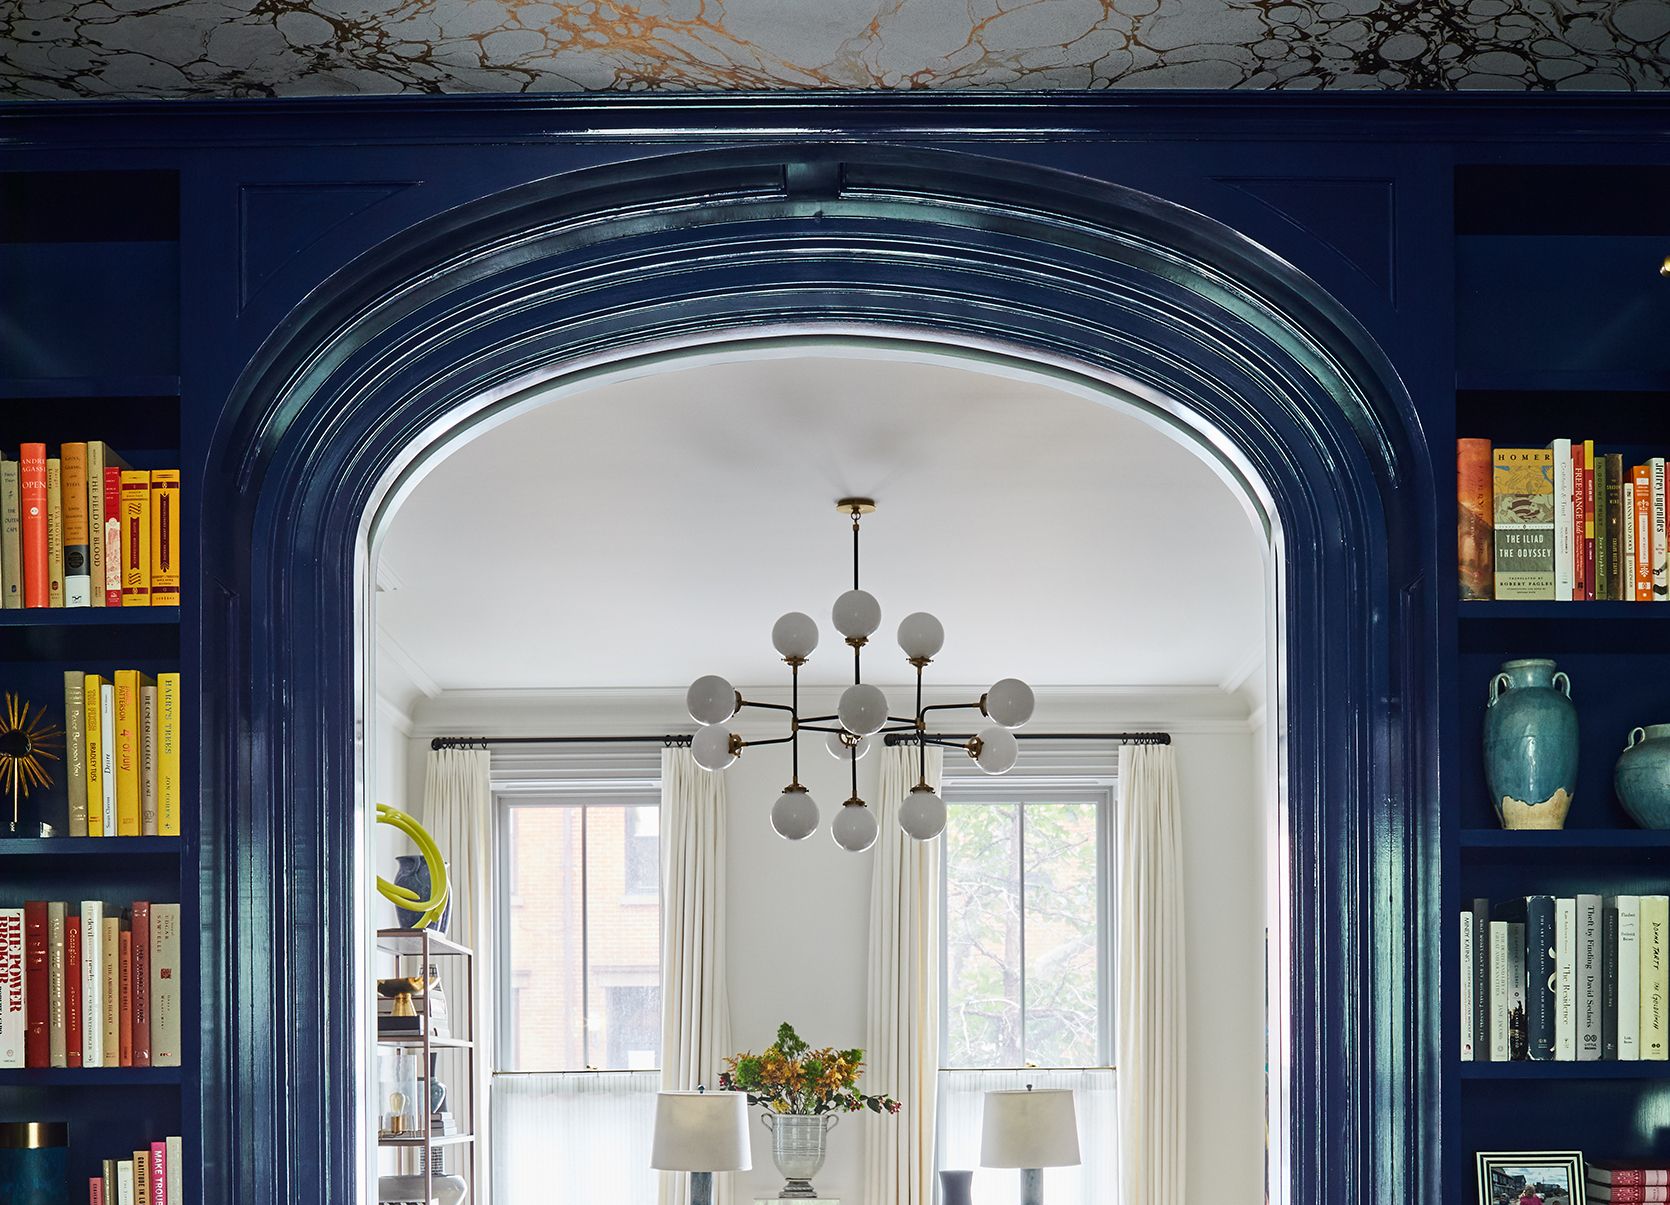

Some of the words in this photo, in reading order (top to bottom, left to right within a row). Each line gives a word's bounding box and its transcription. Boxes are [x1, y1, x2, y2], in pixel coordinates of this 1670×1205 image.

[22, 480, 47, 489] OPEN
[1654, 463, 1665, 491] Jeffrey
[1654, 493, 1665, 533] Eugenides
[93, 523, 99, 534] OF
[1506, 534, 1520, 544] THE
[1523, 534, 1544, 544] ILIAD
[1499, 549, 1514, 558] THE
[1517, 548, 1552, 558] ODYSSEY
[164, 680, 172, 720] HARRY'S
[72, 731, 80, 741] Be
[73, 762, 81, 777] You
[121, 754, 132, 771] July
[1587, 905, 1595, 927] Theft
[9, 913, 22, 952] THE
[1585, 928, 1594, 937] by
[1652, 922, 1661, 944] DONNA
[1586, 939, 1594, 969] Finding
[1652, 947, 1660, 970] TARTT
[9, 954, 22, 1013] POWER
[1563, 964, 1571, 982] The
[1586, 975, 1594, 998] David
[1563, 985, 1571, 1025] Residence
[1586, 999, 1594, 1028] Sedaris
[137, 1156, 145, 1187] GRATITUDE
[154, 1150, 163, 1175] MAKE
